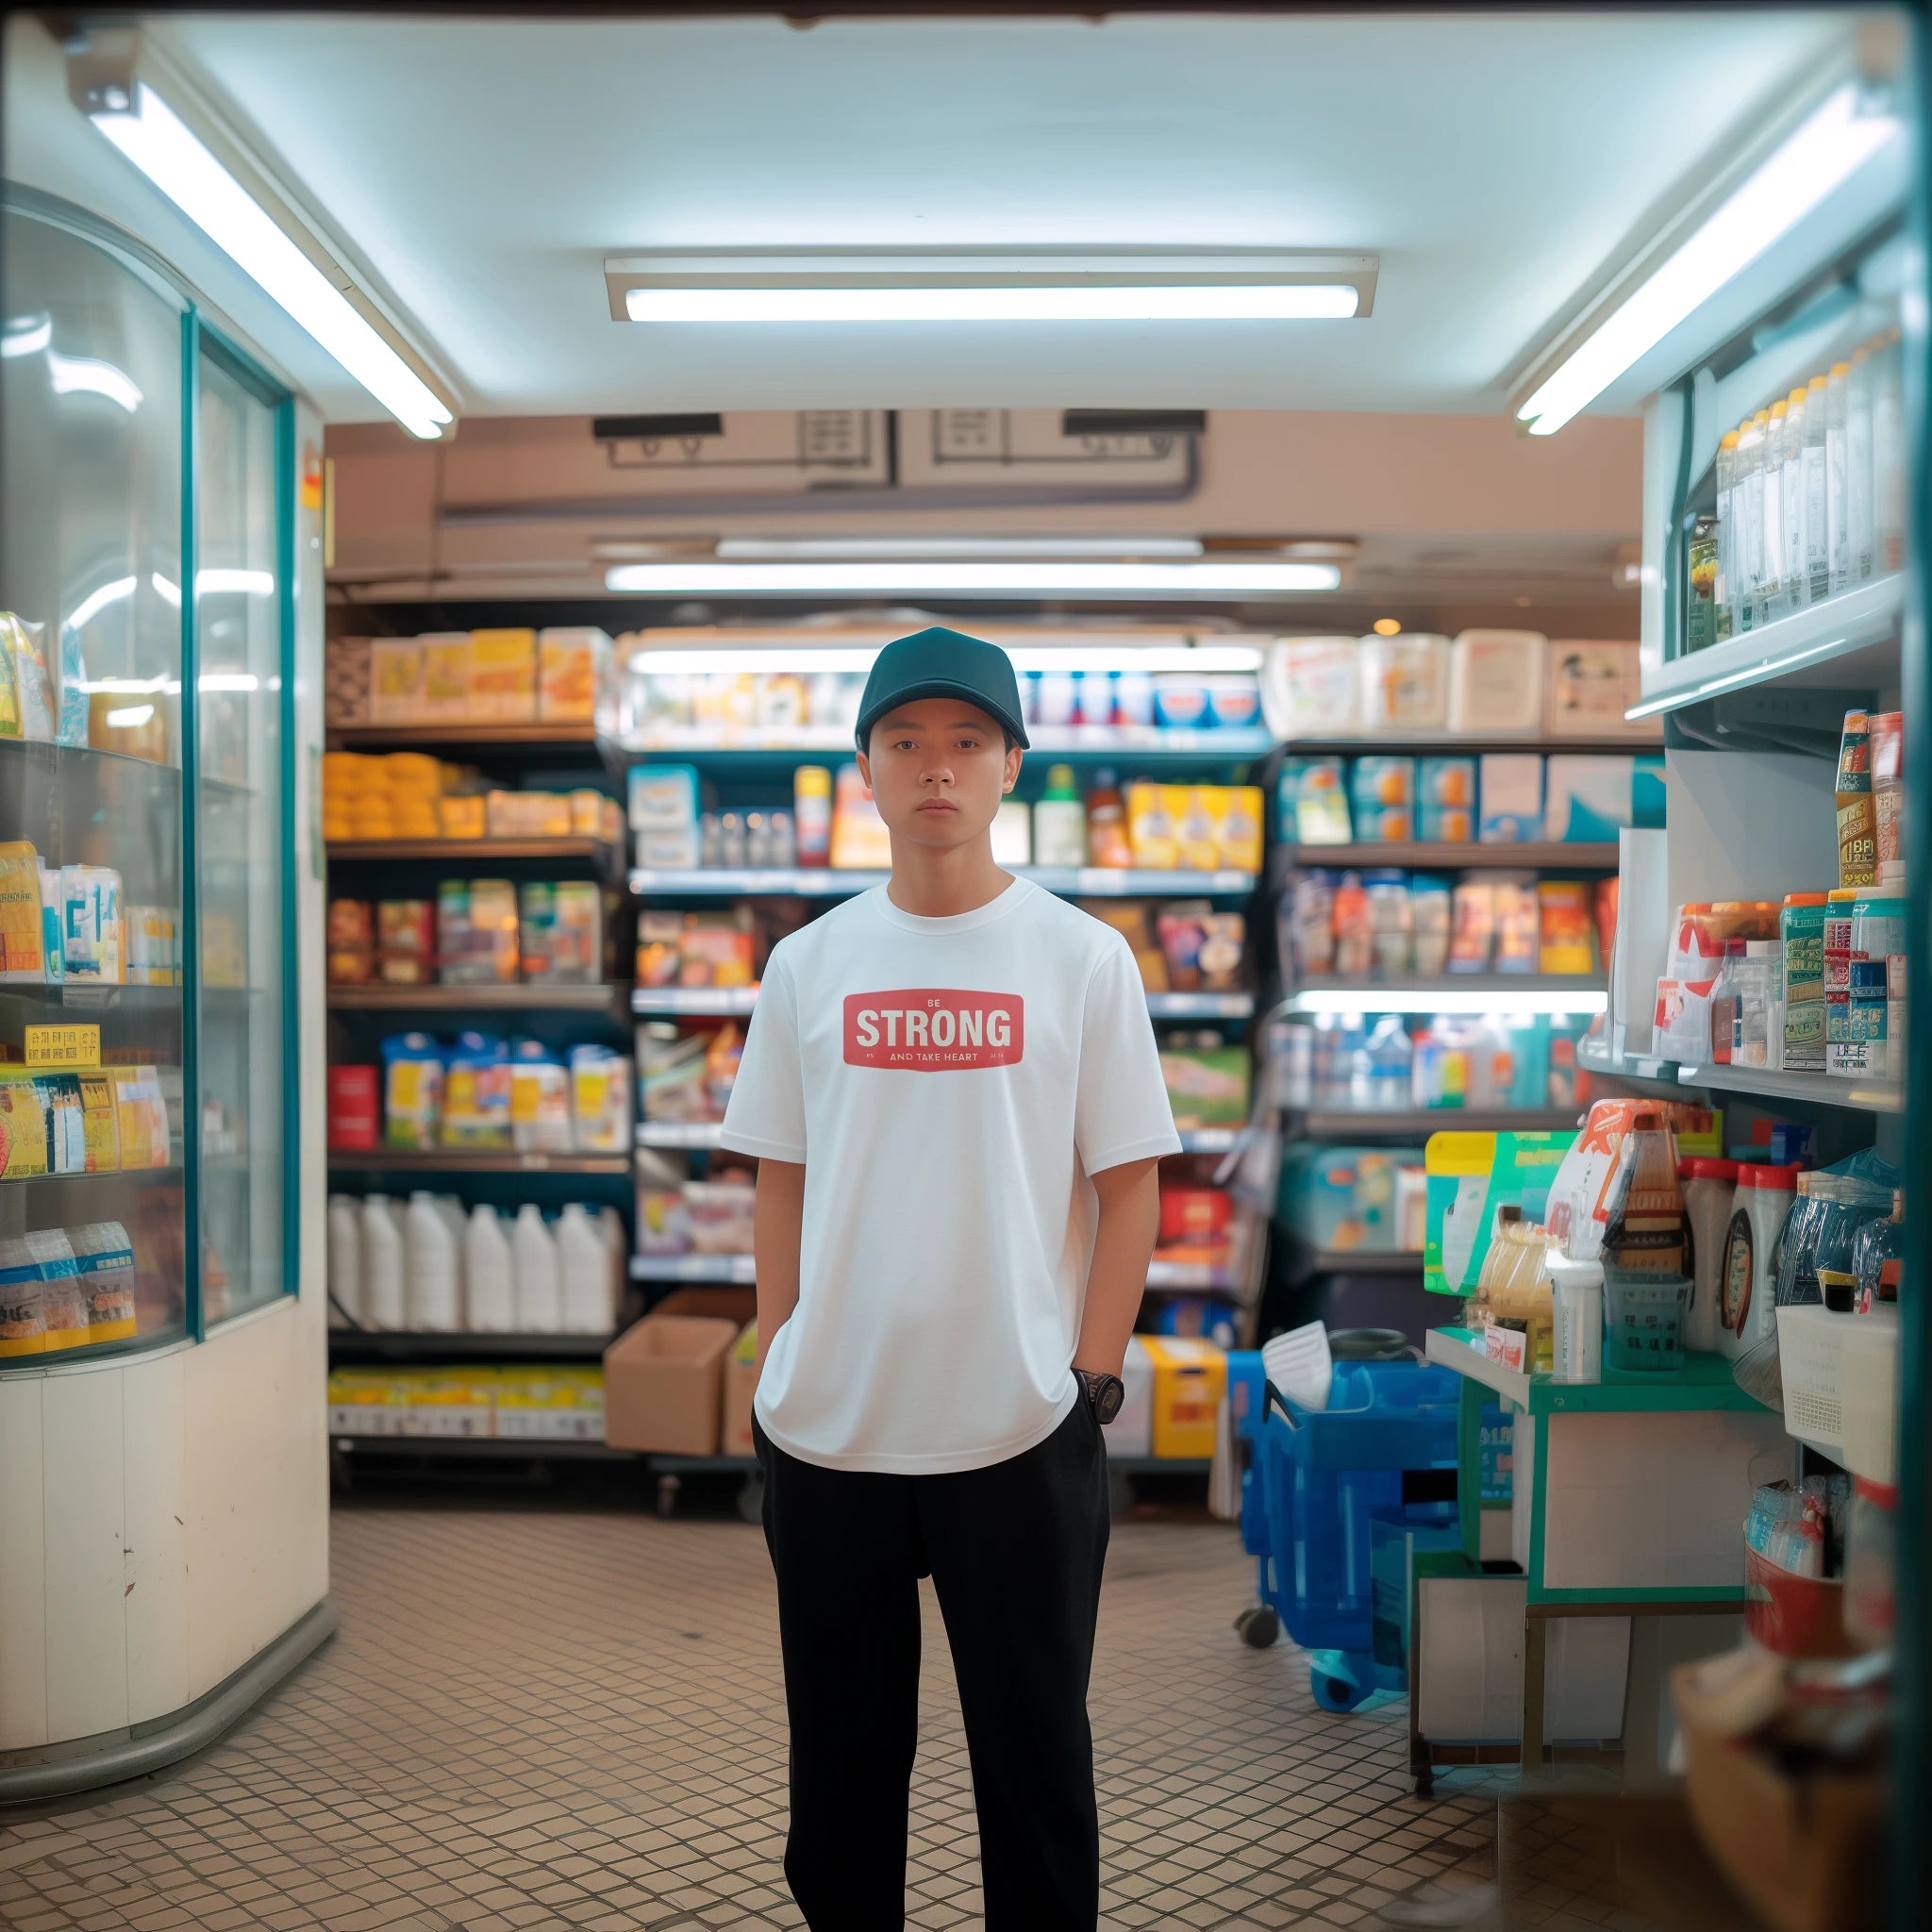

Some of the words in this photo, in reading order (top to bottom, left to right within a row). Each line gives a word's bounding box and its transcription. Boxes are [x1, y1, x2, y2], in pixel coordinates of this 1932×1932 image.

[927, 999, 941, 1008] BE
[857, 1009, 1011, 1047] STRONG
[890, 1053, 913, 1061] AND
[917, 1053, 941, 1061] TAKE
[944, 1053, 978, 1061] HEART
